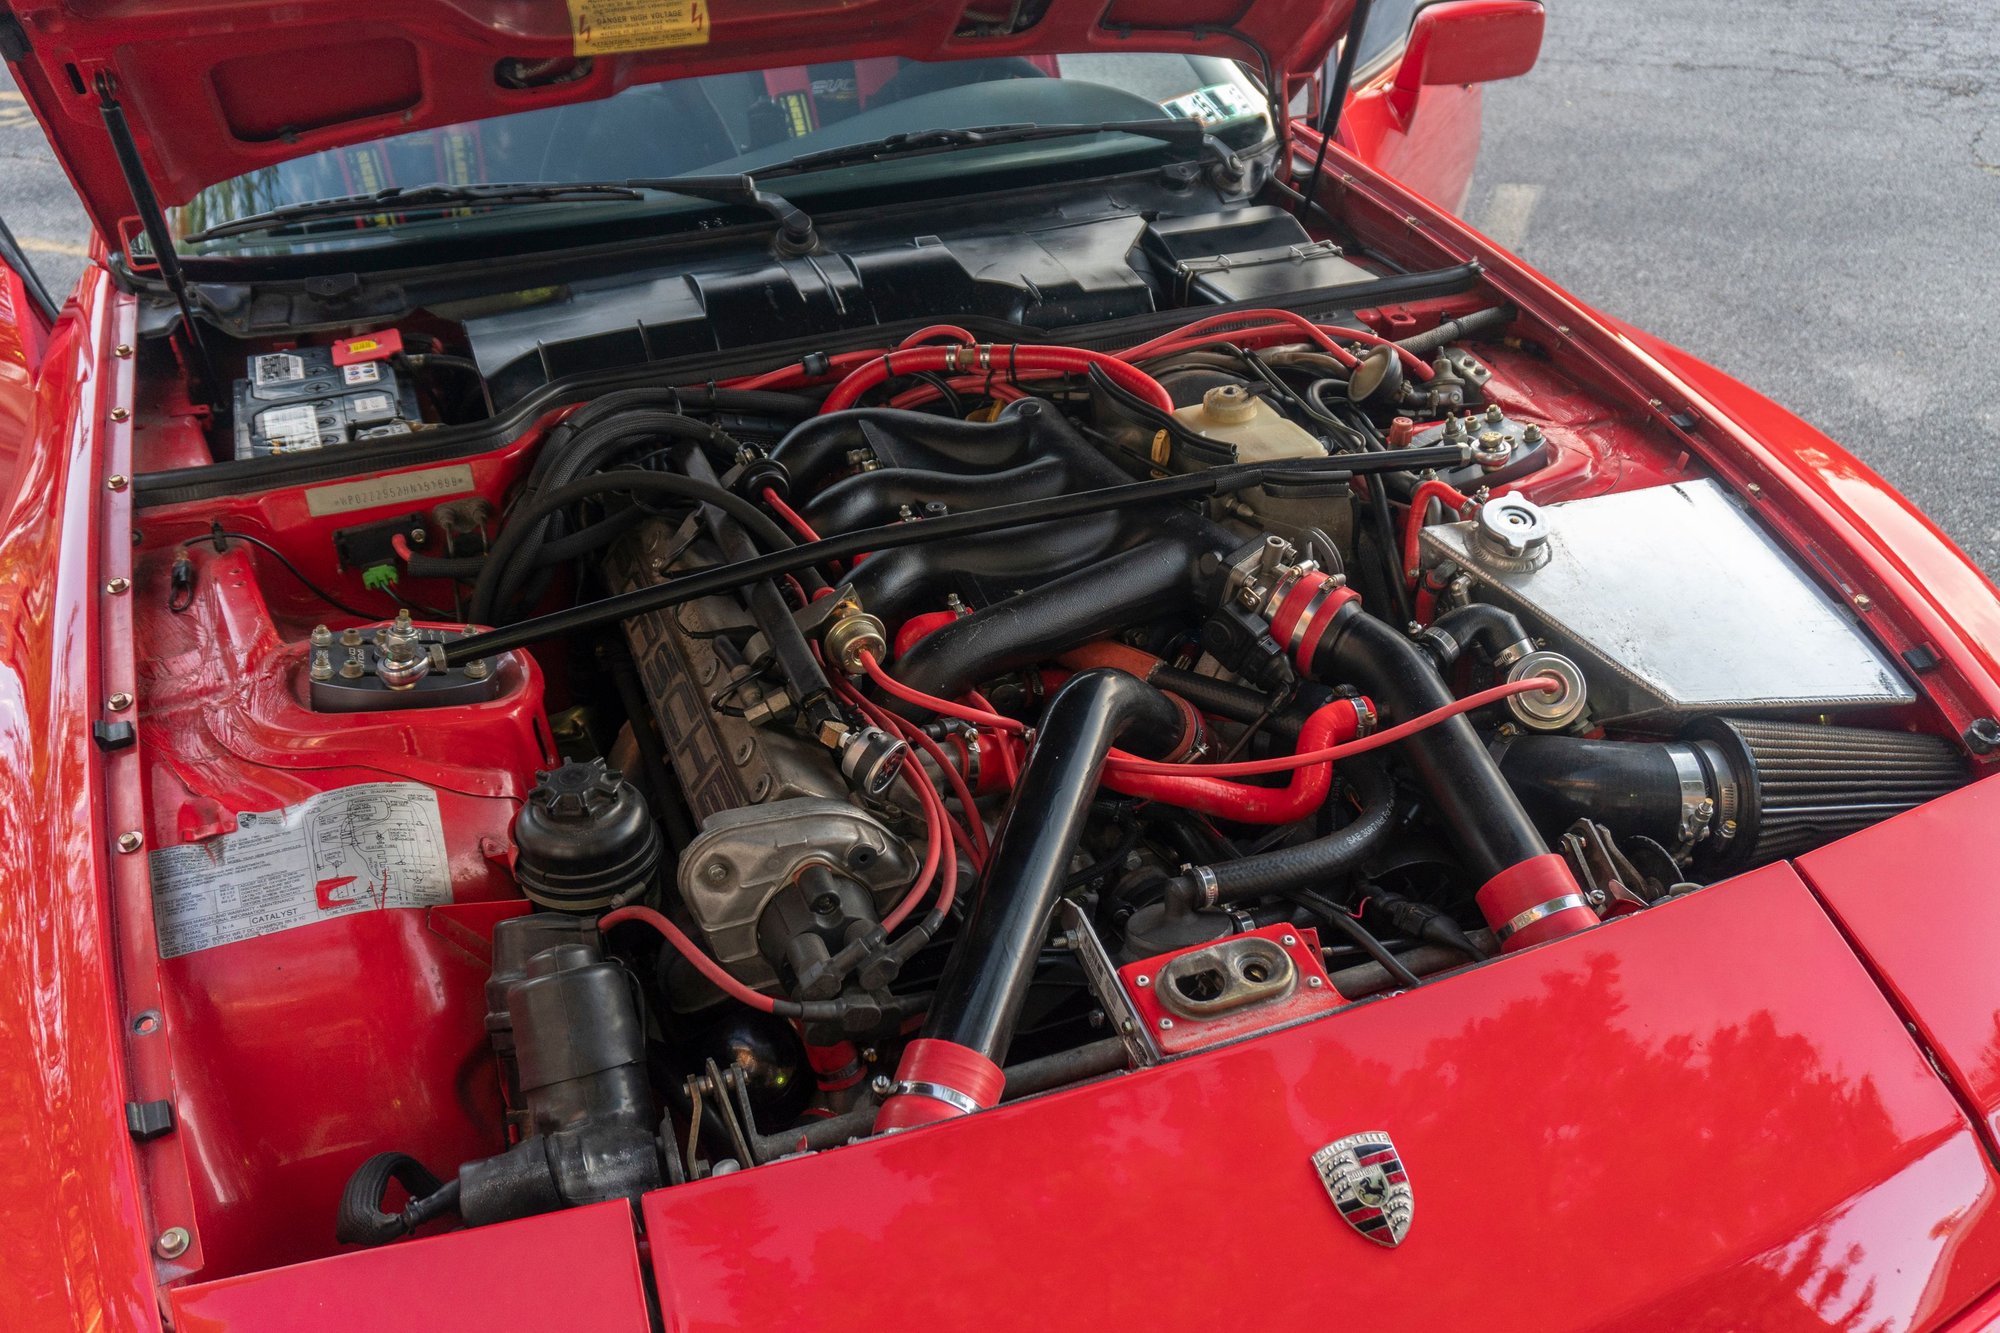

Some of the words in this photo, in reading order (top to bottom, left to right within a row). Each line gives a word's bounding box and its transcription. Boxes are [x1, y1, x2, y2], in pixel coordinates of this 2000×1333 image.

[596, 14, 626, 26] DANGER
[630, 13, 647, 21] HIGH
[651, 9, 682, 19] VOLTAGE
[1346, 833, 1363, 845] SAE
[1375, 817, 1387, 828] Not
[251, 907, 298, 924] CATALYST
[1317, 1133, 1389, 1163] PORSCHE
